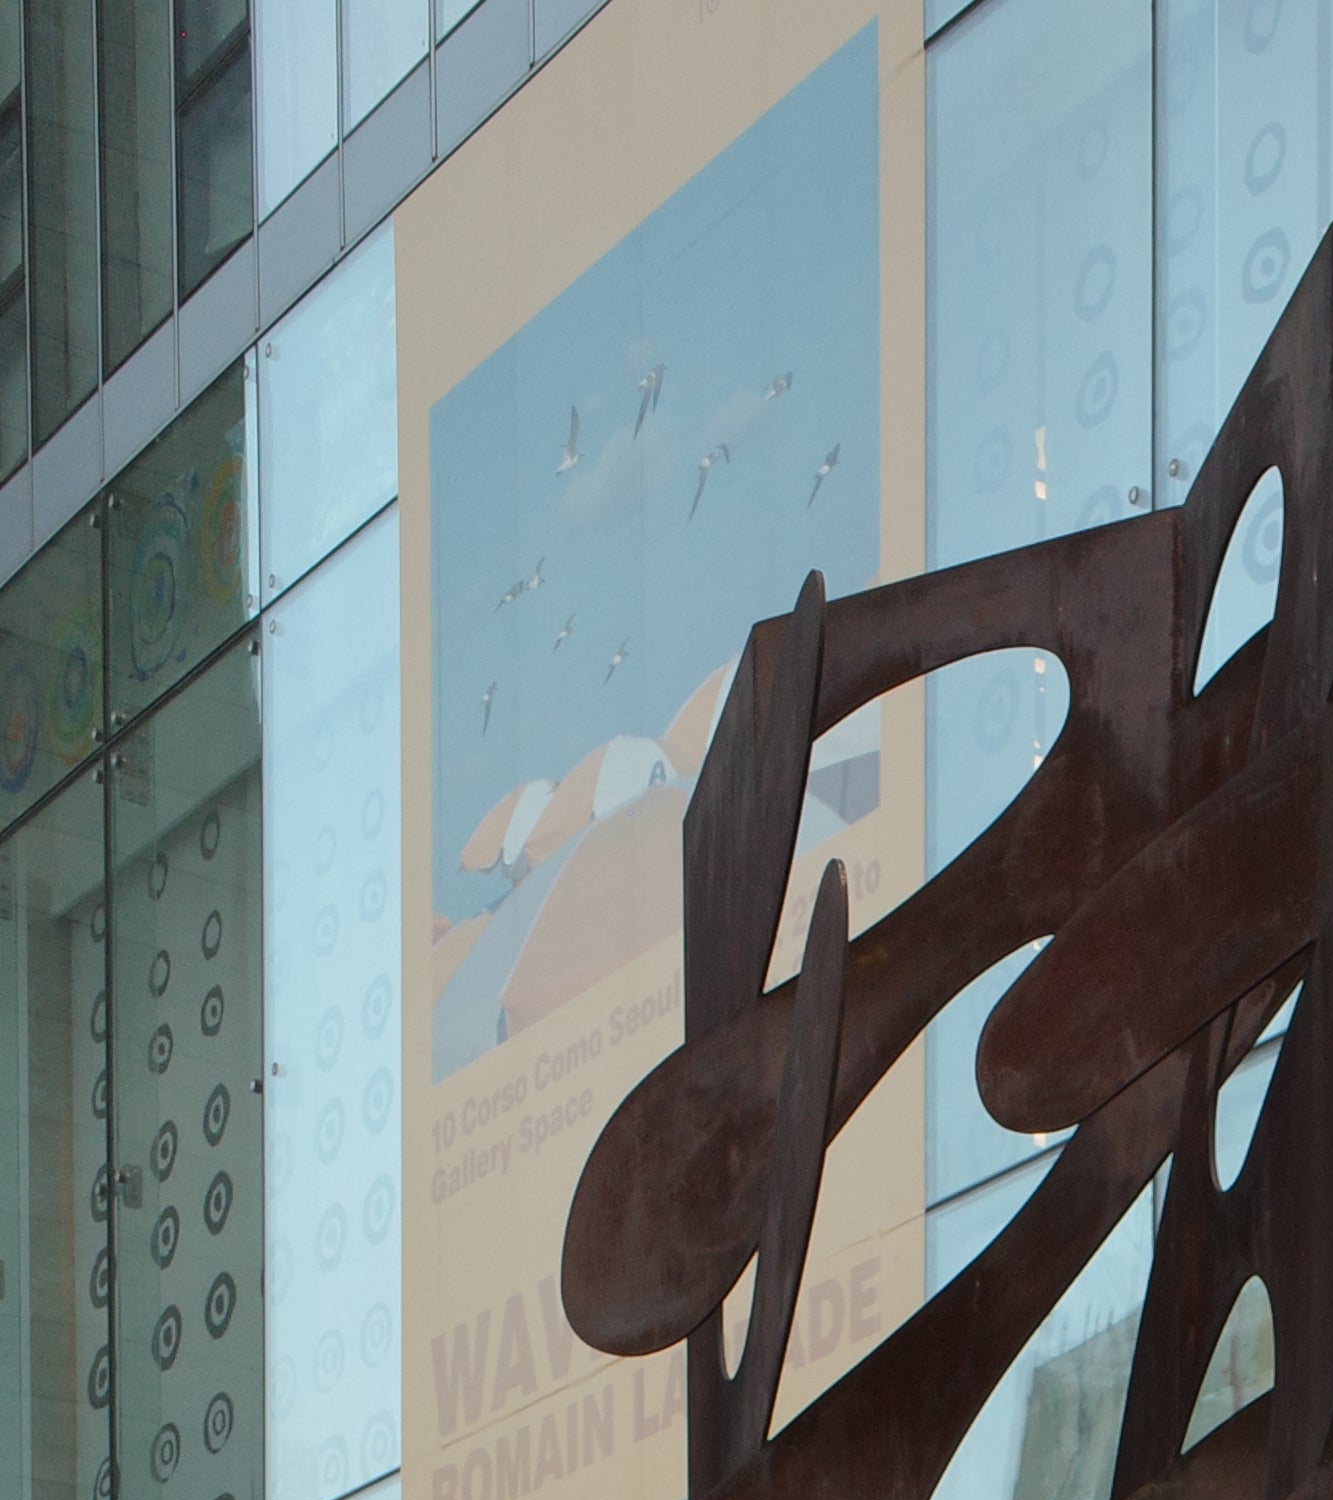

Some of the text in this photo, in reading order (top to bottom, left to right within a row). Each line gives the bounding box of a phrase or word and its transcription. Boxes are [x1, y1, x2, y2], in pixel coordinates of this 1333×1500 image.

[431, 968, 682, 1155] 10 Corso Como Seoul
[431, 1087, 594, 1205] Gallery Space
